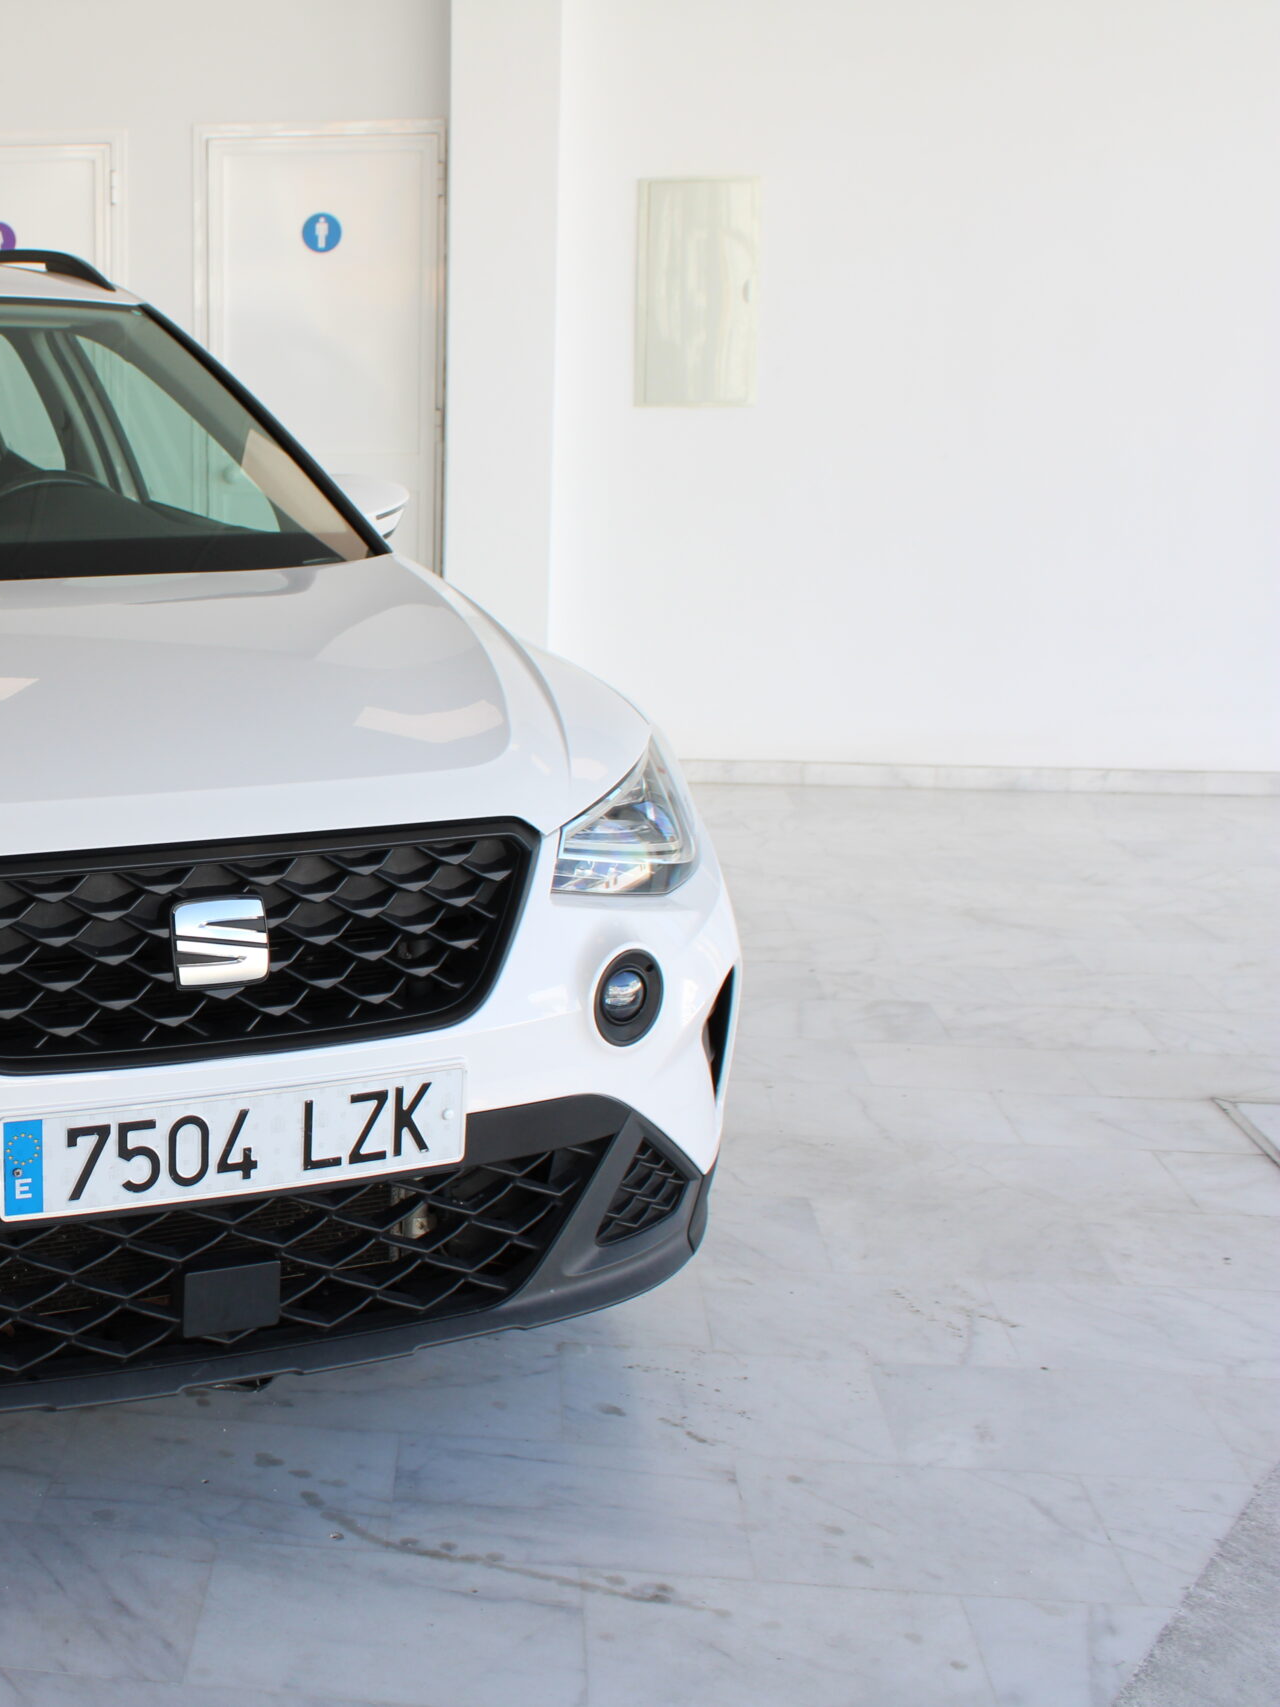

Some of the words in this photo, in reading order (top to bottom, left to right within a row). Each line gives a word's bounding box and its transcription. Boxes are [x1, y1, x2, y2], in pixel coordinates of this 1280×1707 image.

[66, 1108, 258, 1201] 7504
[303, 1081, 433, 1171] LZK
[15, 1178, 32, 1199] E
